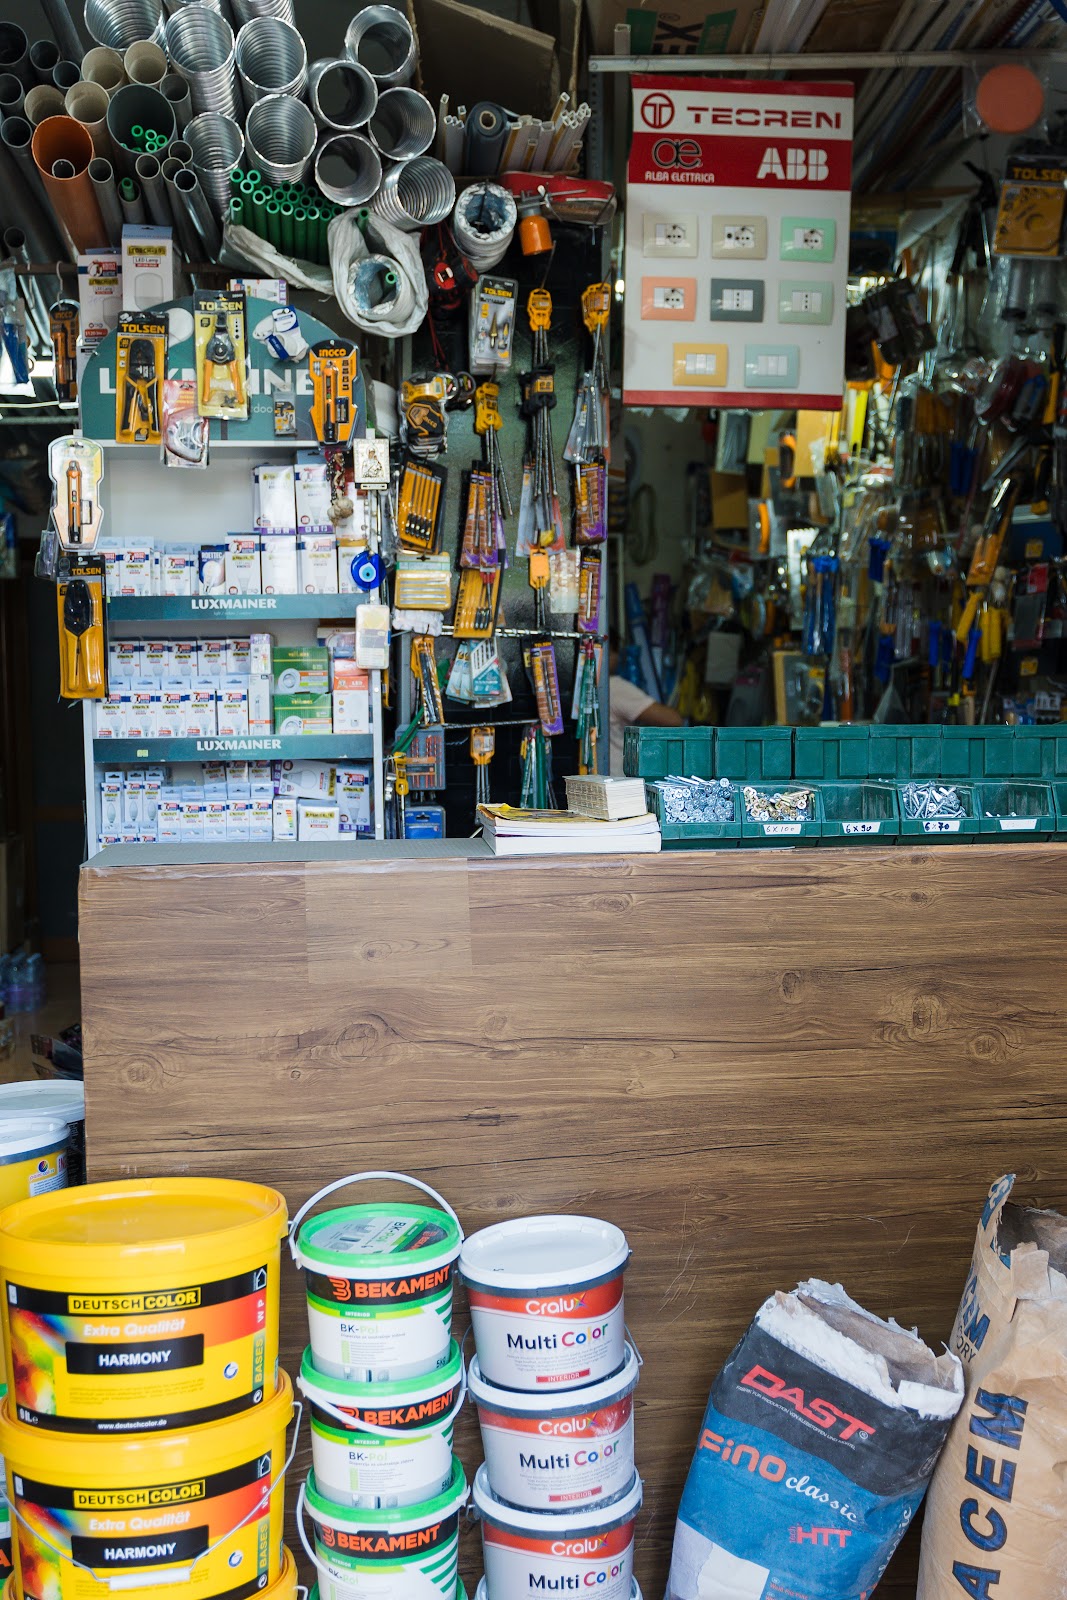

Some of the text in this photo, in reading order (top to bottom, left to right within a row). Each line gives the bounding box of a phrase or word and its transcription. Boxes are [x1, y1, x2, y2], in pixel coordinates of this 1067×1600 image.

[756, 147, 829, 182] ABB
[645, 170, 715, 184] ALBA ELETTRICA
[484, 287, 513, 298] TOLSEN
[199, 301, 244, 311] TOLSEN
[121, 323, 166, 333] TOLSEN
[71, 567, 102, 576] TOLSEN
[191, 598, 278, 610] LUXMAINER
[196, 739, 282, 751] LUXMAINER
[354, 1264, 451, 1299] BEKAMENT
[525, 1293, 588, 1315] Cralux
[344, 1310, 371, 1318] INTERIOR
[83, 1318, 186, 1337] Extra Qualität
[340, 1322, 379, 1334] BK-Pol
[506, 1323, 609, 1350] Multi Color
[97, 1350, 172, 1367] HARMONY
[254, 1338, 263, 1384] BASES
[547, 1372, 580, 1382] INTERIOR
[363, 1390, 454, 1426] BEKAMENT
[740, 1364, 877, 1440] DAST
[97, 1419, 168, 1430] www.deutschcolor.de
[538, 1412, 598, 1435] Cralux
[354, 1438, 380, 1446] INTERIOR
[348, 1451, 388, 1462] BK-Pol
[519, 1440, 620, 1469] Multi Color
[560, 1490, 592, 1501] INTERIOR
[785, 1475, 857, 1523] classic
[89, 1510, 191, 1532] Extra Qualität
[259, 1524, 268, 1569] BASES
[337, 1524, 441, 1553] BEKAMENT
[551, 1532, 609, 1556] Cralux
[797, 1526, 852, 1548] HTT
[104, 1542, 177, 1561] HARMONY
[528, 1560, 625, 1590] Multi Color
